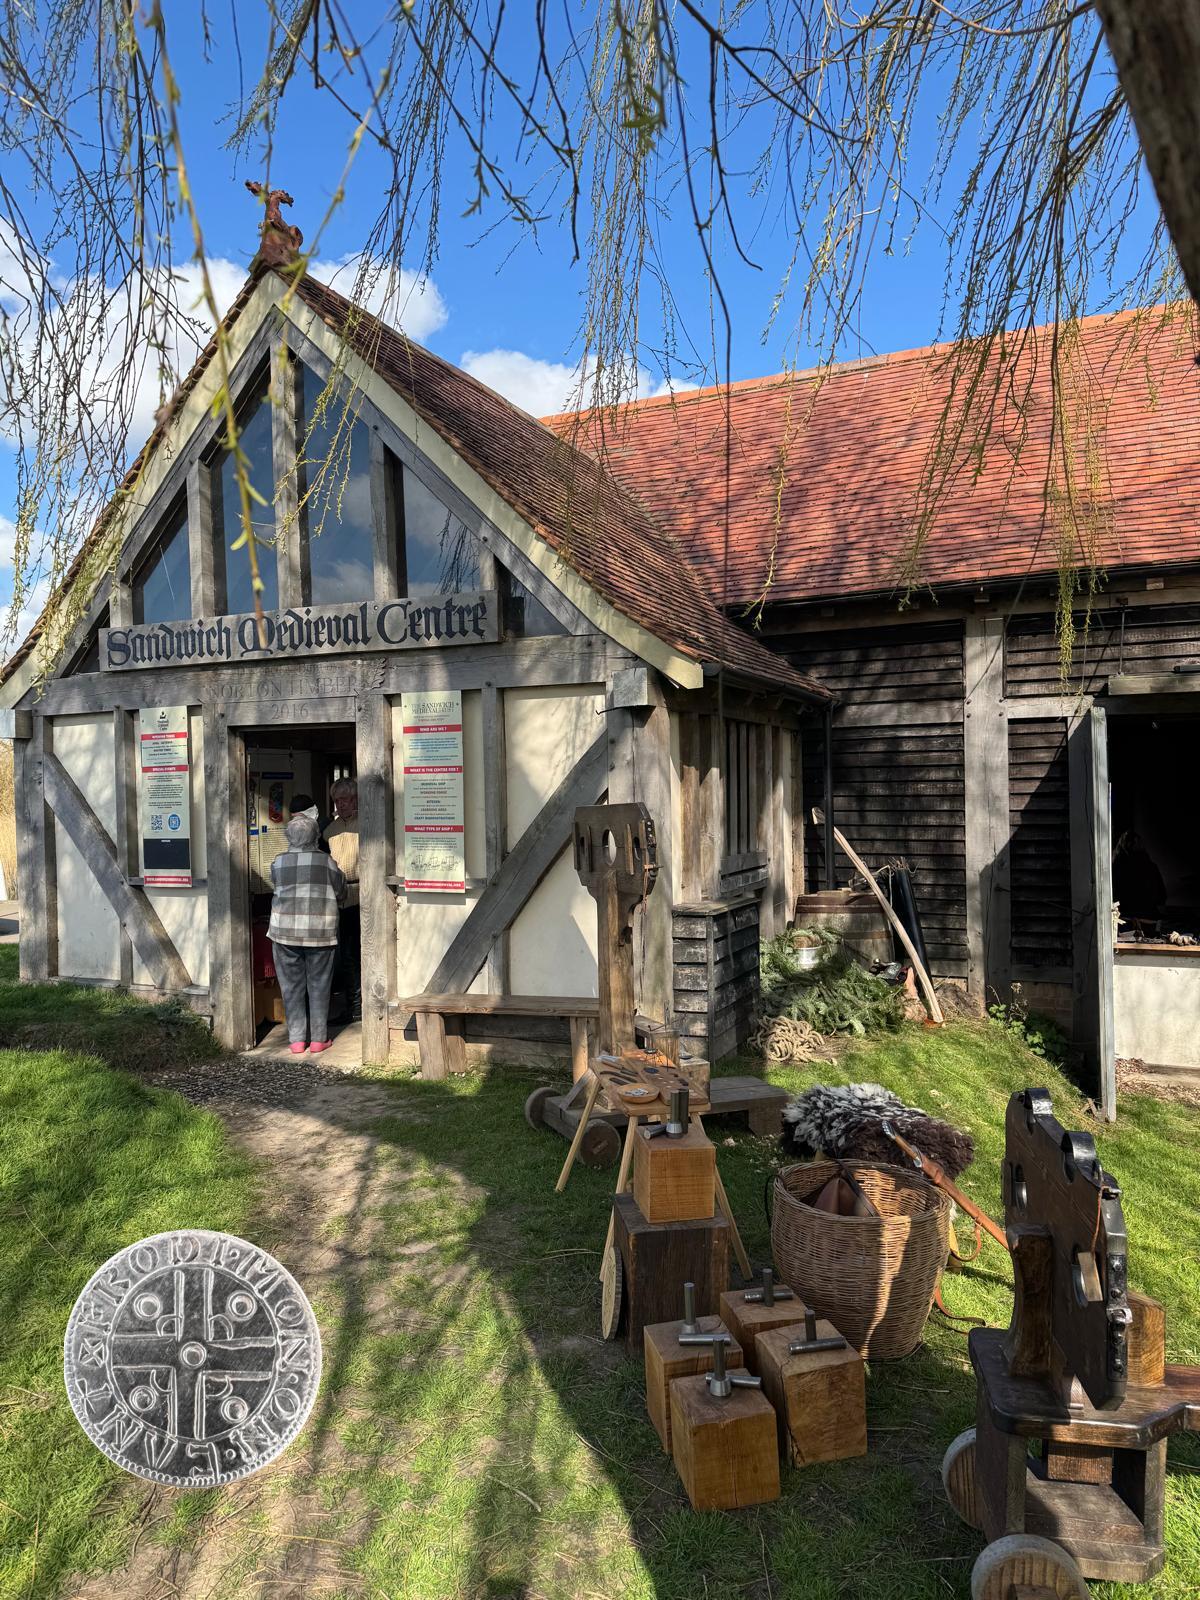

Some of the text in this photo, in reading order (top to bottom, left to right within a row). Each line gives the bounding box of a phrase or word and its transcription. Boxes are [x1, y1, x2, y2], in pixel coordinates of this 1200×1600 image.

[107, 597, 488, 666] Sandwich Medieval Centre
[271, 703, 309, 719] 2016
